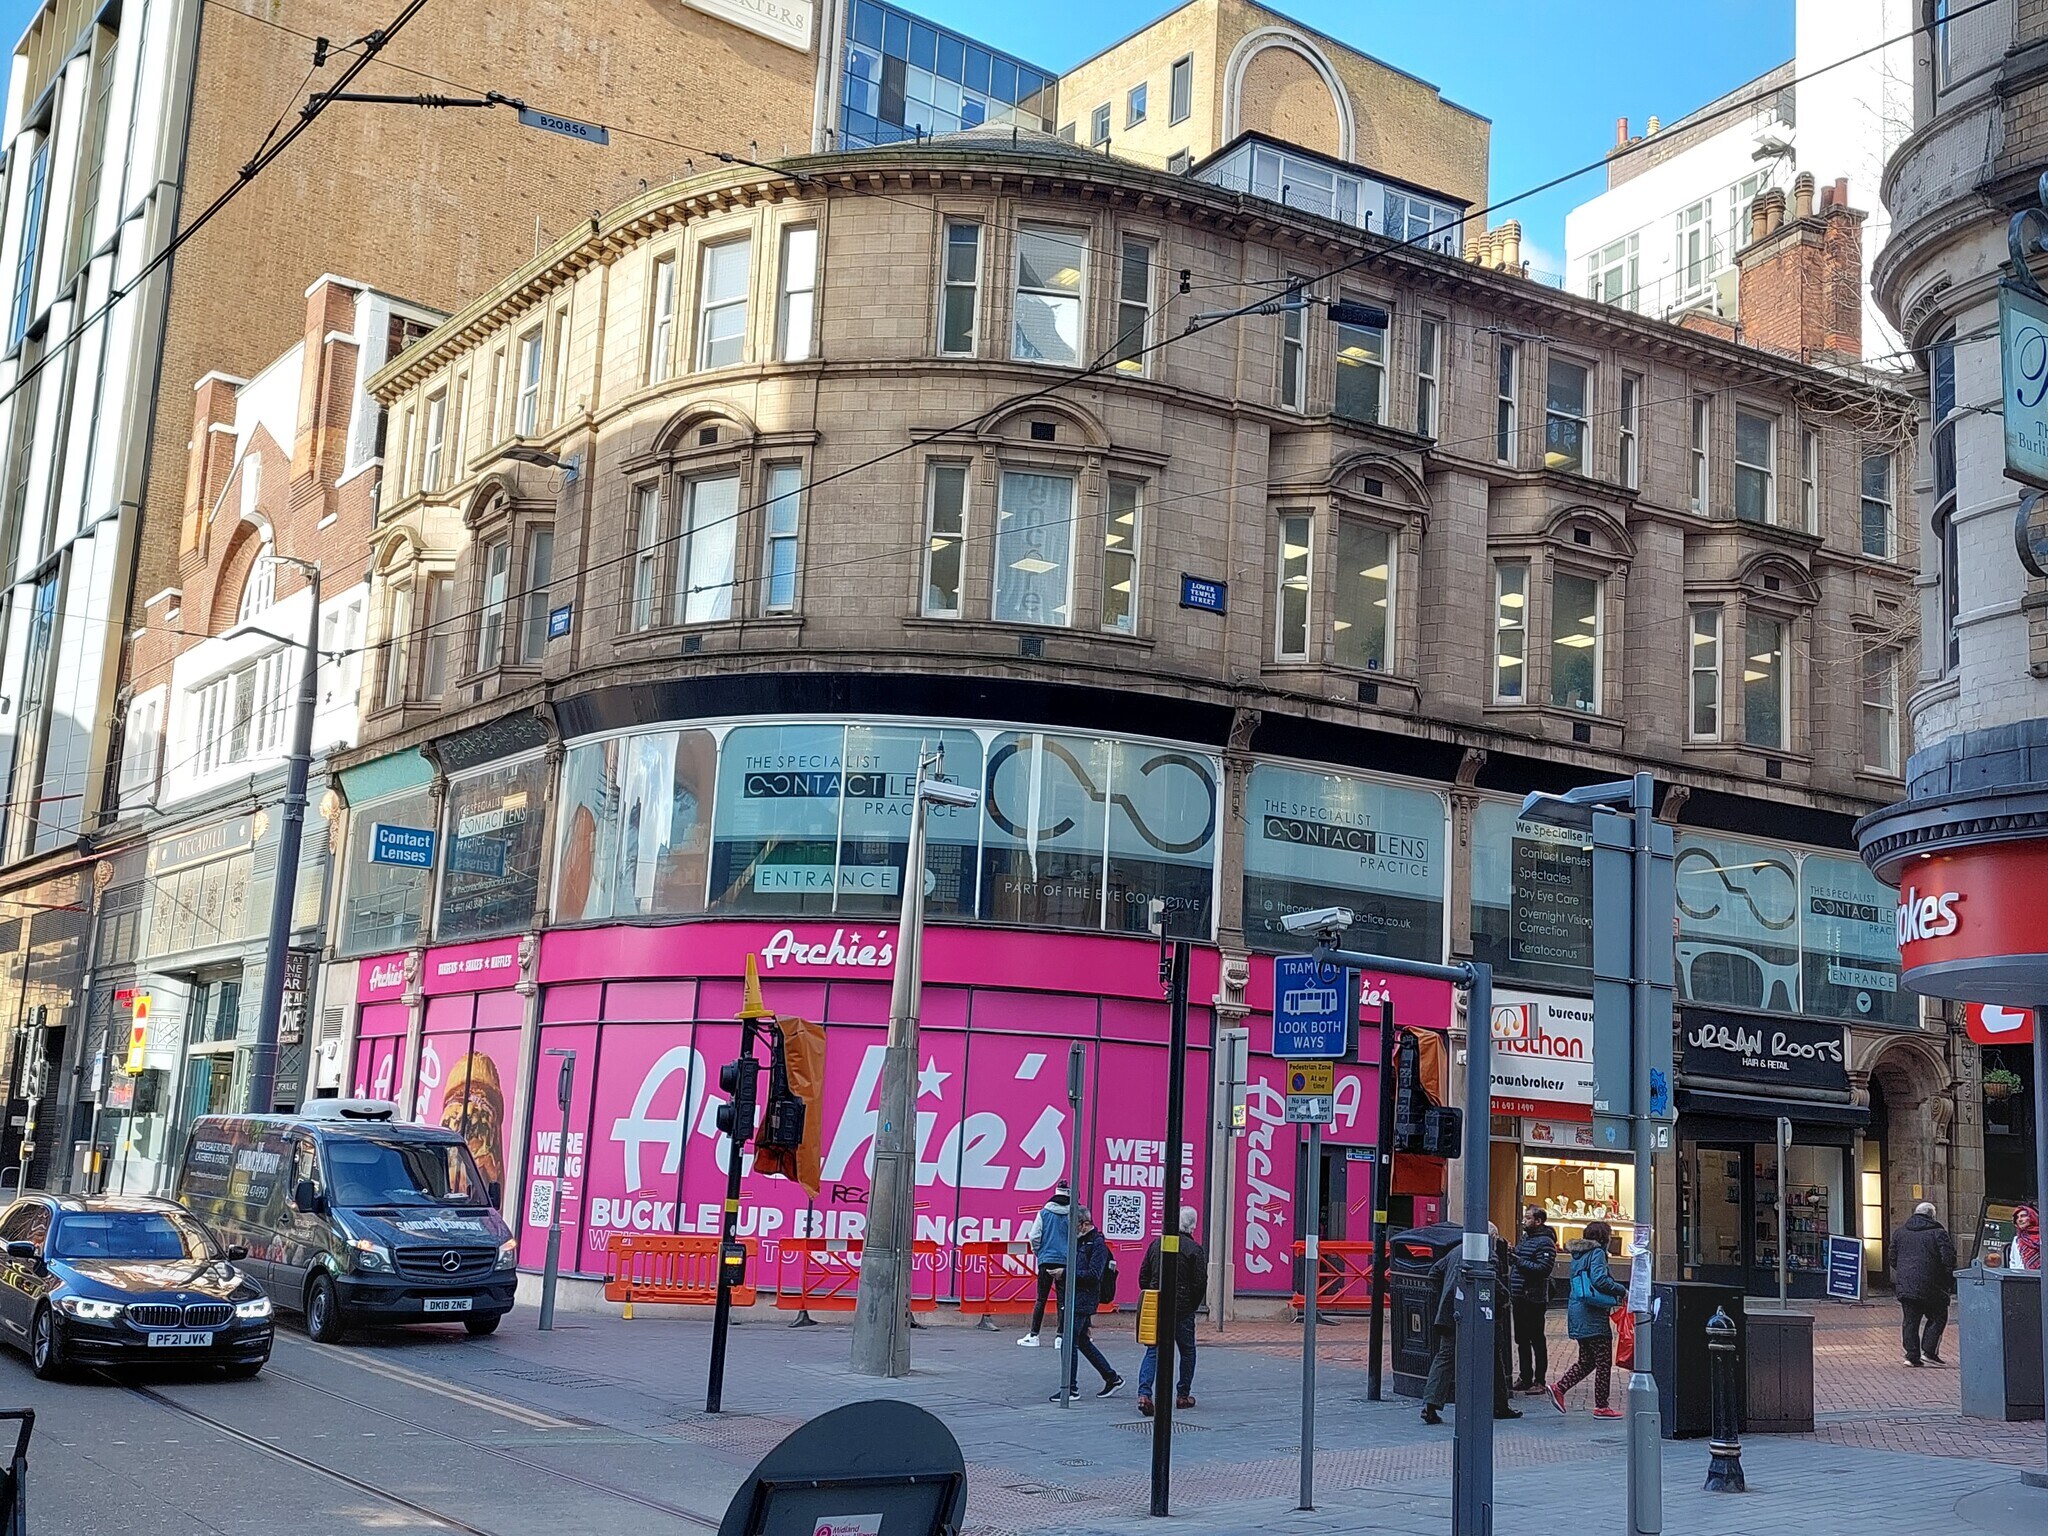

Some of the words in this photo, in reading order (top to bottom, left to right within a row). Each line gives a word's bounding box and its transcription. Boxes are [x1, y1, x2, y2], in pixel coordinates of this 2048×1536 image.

[540, 116, 587, 136] B20856
[1190, 589, 1216, 600] TEMPLE
[1192, 583, 1215, 592] LOWER
[1190, 596, 1215, 605] STREET
[745, 755, 773, 769] THE
[776, 755, 881, 770] SPECIALIST
[747, 775, 883, 796] CONTACT
[864, 802, 958, 818] PRACICE
[1264, 799, 1287, 814] THE
[1291, 804, 1372, 828] SPECIALIST
[460, 810, 503, 835] CONTACT
[504, 807, 526, 825] LENS
[379, 829, 430, 848] Contact
[1267, 819, 1373, 850] CONTACT
[1377, 836, 1426, 859] LENS
[1515, 821, 1531, 833] We
[1533, 824, 1583, 842] Specialise
[176, 827, 228, 859] PICCADILLY
[381, 845, 426, 862] Lenses
[1519, 846, 1559, 862] Contact
[1561, 853, 1591, 867] Lenses
[1360, 857, 1428, 877] PRACTICE
[1519, 867, 1571, 884] Spectacles
[761, 871, 892, 888] ENTRANCE
[1004, 882, 1038, 896] PART
[1043, 885, 1062, 896] OF
[1067, 887, 1091, 899] THE
[1095, 890, 1120, 902] EYE
[1519, 887, 1535, 901] Dry
[1537, 890, 1554, 904] Eye
[1556, 893, 1579, 905] Care
[1811, 885, 1825, 897] THE
[1826, 887, 1875, 903] SPECIALIST
[1519, 907, 1565, 924] Overnight
[1567, 913, 1593, 926] Vision
[1812, 898, 1877, 921] CONTACT
[1519, 921, 1569, 938] Correction
[761, 929, 893, 969] Archie's
[1519, 942, 1578, 959] Keratoconus
[284, 978, 301, 990] AR
[1832, 969, 1894, 988] ENTRANCE
[1548, 1005, 1594, 1022] bureaux
[1278, 1021, 1307, 1034] LOOK
[1311, 1021, 1341, 1033] BOTH
[1293, 1036, 1324, 1049] WAYS
[1688, 1024, 1762, 1057] URBAN
[1742, 1057, 1759, 1066] HAIR
[1760, 1059, 1766, 1067] &
[1767, 1060, 1790, 1070] RETAIL
[590, 1197, 720, 1234] BUCKLE
[735, 1205, 783, 1238] UP
[430, 1301, 449, 1310] DK18
[451, 1300, 467, 1309] ZNE
[156, 1334, 182, 1345] PF21
[184, 1333, 206, 1344] JVK
[833, 1523, 861, 1534] Midland
